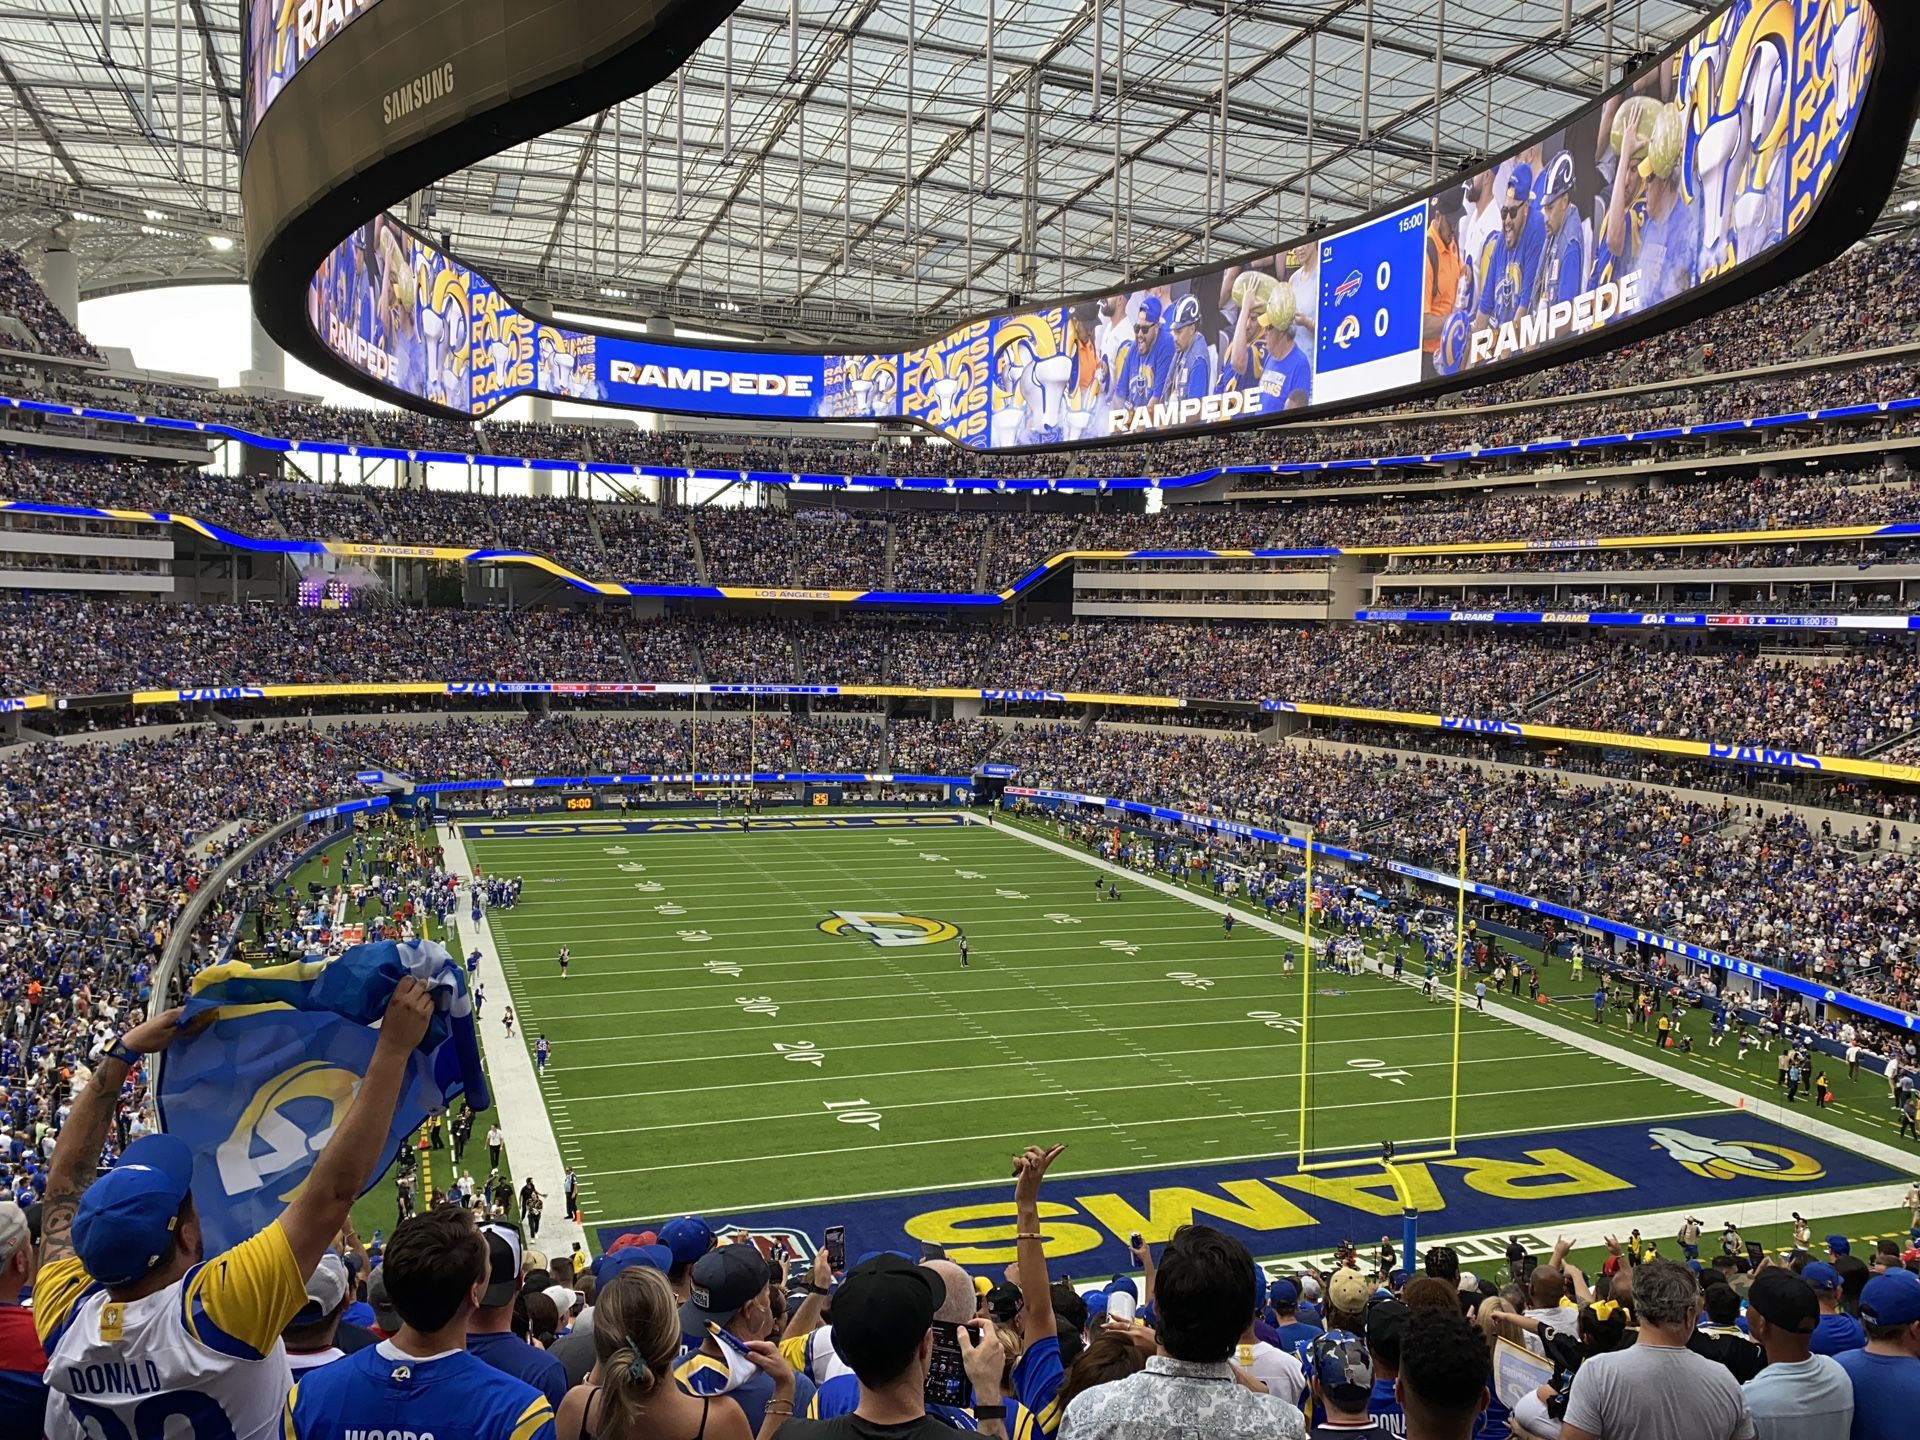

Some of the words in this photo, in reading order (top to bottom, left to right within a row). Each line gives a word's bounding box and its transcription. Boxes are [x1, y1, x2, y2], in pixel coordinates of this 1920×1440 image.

[383, 62, 454, 125] SAMSUNG
[1398, 212, 1423, 233] 15:00
[1323, 247, 1332, 257] Q1
[1376, 261, 1391, 291] 0
[1374, 307, 1389, 337] 0
[1470, 269, 1643, 364] RAMPEDE
[328, 311, 400, 382] RAMPEDE
[609, 359, 813, 397] RAMPEDE
[1108, 386, 1263, 433] RAMPEDE
[379, 547, 434, 556] ANGELES
[1464, 613, 1495, 621] RAMS
[1555, 613, 1590, 622] RAMS
[566, 798, 591, 809] 15:00
[309, 808, 338, 820] HOUSE
[480, 825, 627, 835] LOS
[647, 817, 958, 831] ANGELES
[1043, 913, 1082, 924] 50
[676, 930, 712, 941] 50
[1099, 940, 1142, 953] 40
[1637, 930, 1688, 955] RAMS
[1697, 949, 1763, 979] HOUSE
[703, 960, 743, 974] 40
[1166, 972, 1215, 988] 30
[735, 996, 780, 1013] 30
[1247, 1011, 1304, 1028] 20
[773, 1040, 825, 1062] 20
[1346, 1059, 1414, 1079] 10
[823, 1098, 882, 1123] 10
[905, 1148, 1635, 1265] RAMS
[68, 1360, 161, 1396] DONALD
